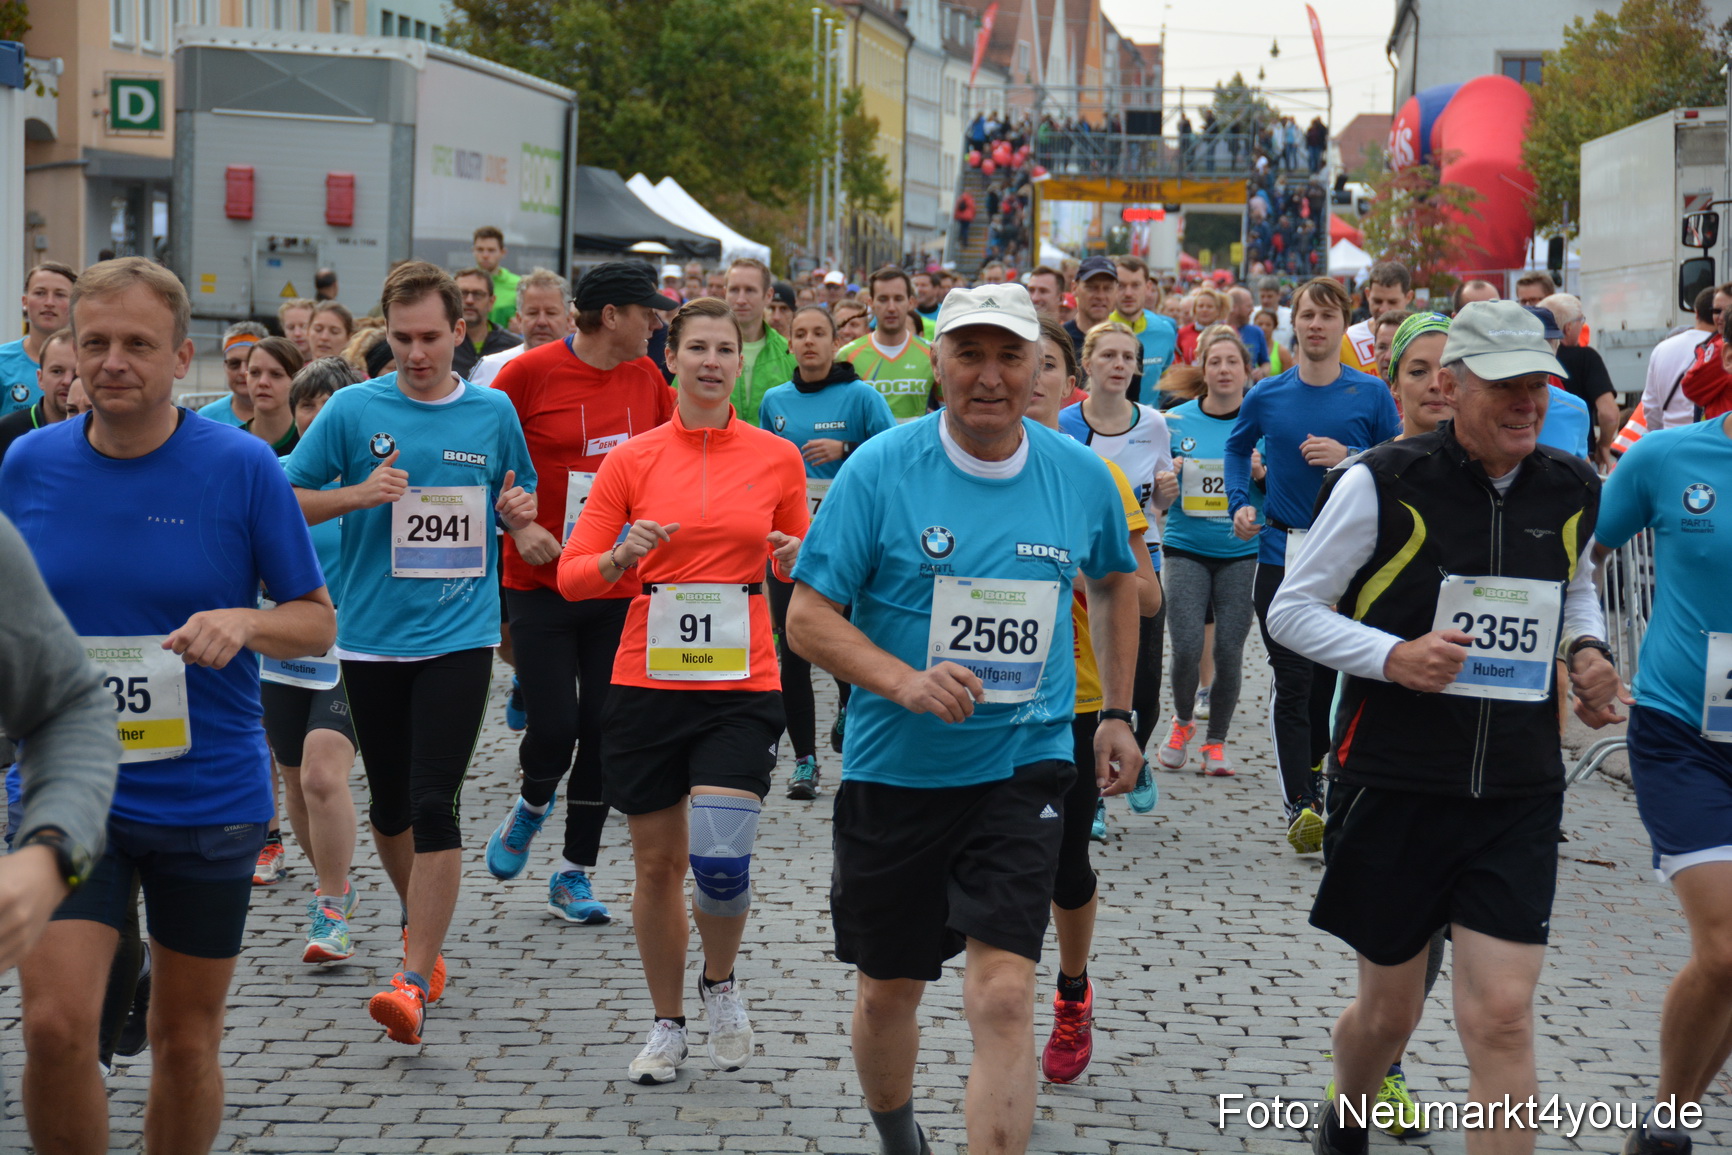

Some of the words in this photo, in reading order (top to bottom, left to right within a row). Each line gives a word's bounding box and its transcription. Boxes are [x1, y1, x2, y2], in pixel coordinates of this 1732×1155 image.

[118, 85, 155, 124] D
[814, 421, 847, 431] BOCK
[599, 440, 618, 450] DEHN
[443, 450, 487, 466] BOCK
[1202, 477, 1224, 494] 82
[431, 494, 463, 504] BOCK
[147, 516, 184, 525] FALKE
[1681, 518, 1715, 528] PARTL
[407, 514, 469, 542] 2941
[1017, 543, 1072, 564] BOCK
[919, 563, 955, 573] PARTL
[686, 593, 720, 601] BOCK
[984, 590, 1026, 602] BOCK
[1486, 588, 1528, 601] BOCK
[680, 613, 712, 643] 91
[949, 615, 1039, 655] 2568
[1452, 611, 1539, 653] 2355
[96, 649, 143, 659] BOCK
[682, 653, 714, 664] Nicole
[281, 660, 316, 674] Christine
[1473, 662, 1515, 678] Hubert
[103, 676, 151, 714] 35
[117, 727, 145, 741] ther
